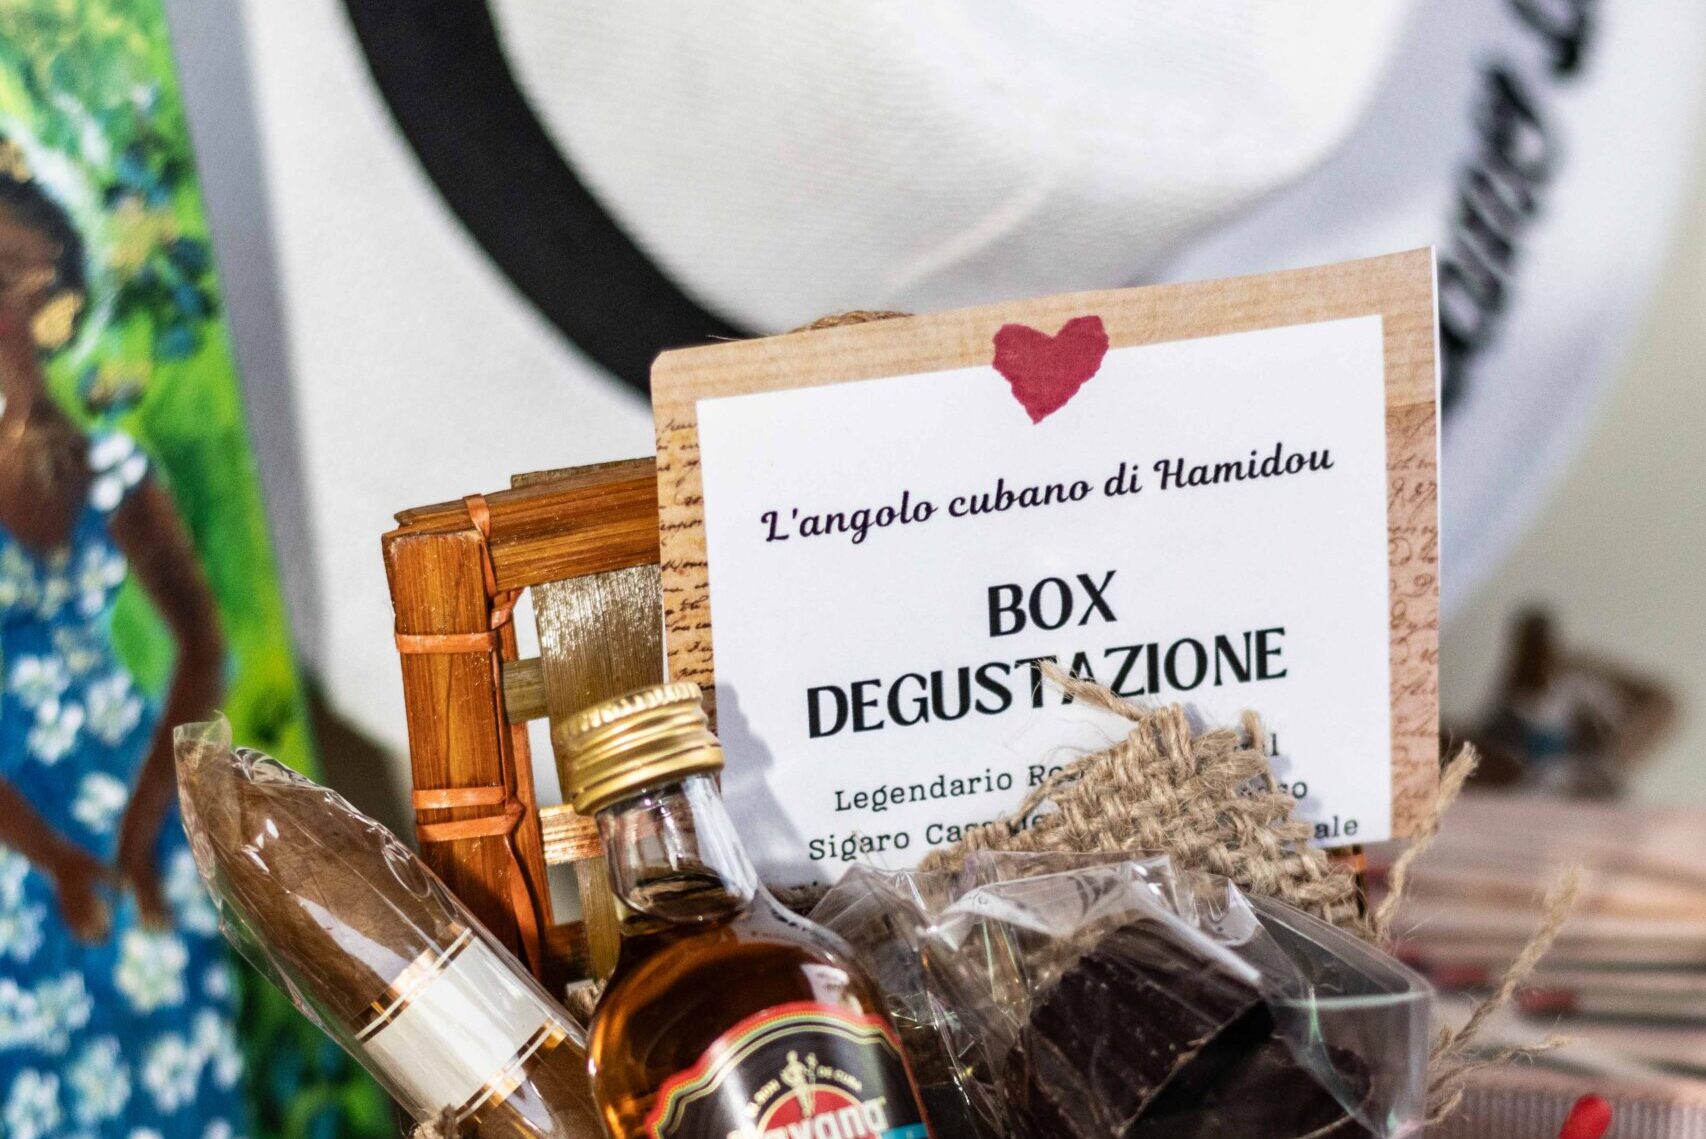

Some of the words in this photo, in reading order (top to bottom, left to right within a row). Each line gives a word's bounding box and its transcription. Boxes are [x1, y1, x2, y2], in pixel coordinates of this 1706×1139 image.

[760, 490, 938, 545] L'angolo
[948, 478, 1093, 518] cubano
[1104, 462, 1142, 497] di
[1153, 442, 1335, 490] Hamidou
[987, 570, 1117, 638] BOX
[807, 627, 1287, 739] DEGUSTAZIONE
[834, 768, 1013, 812] Legendario
[809, 832, 910, 862] Sigaro
